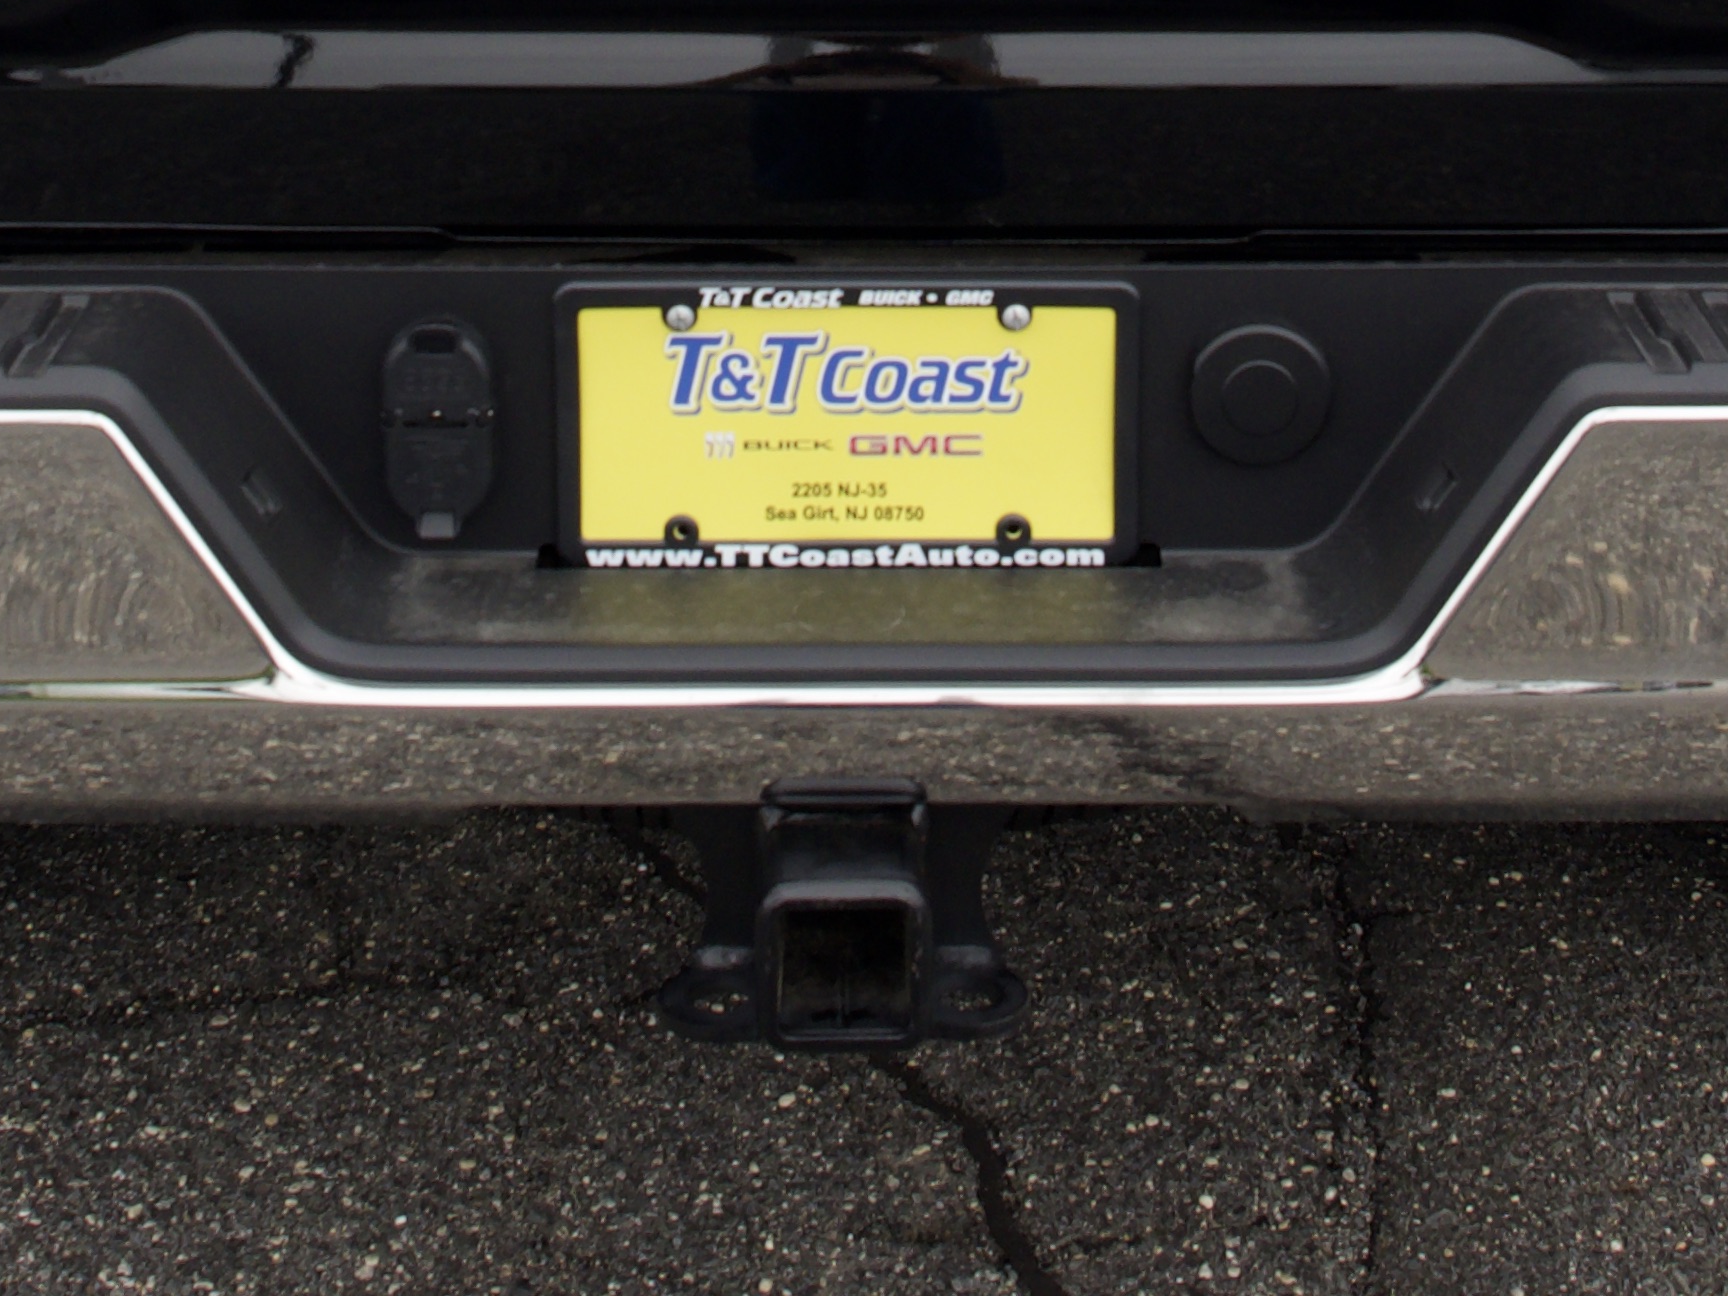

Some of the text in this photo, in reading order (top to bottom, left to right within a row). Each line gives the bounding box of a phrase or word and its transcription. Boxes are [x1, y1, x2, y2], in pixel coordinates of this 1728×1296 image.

[698, 287, 995, 309] T&T Coast BUICK GMC
[666, 332, 1027, 412] T&T Coast
[742, 434, 984, 457] BUICK GMC
[791, 482, 888, 499] 2205 NJ-35
[765, 506, 925, 523] Sea Girt, NJ 08750
[584, 542, 1107, 569] www.TTCoastAuto.com
